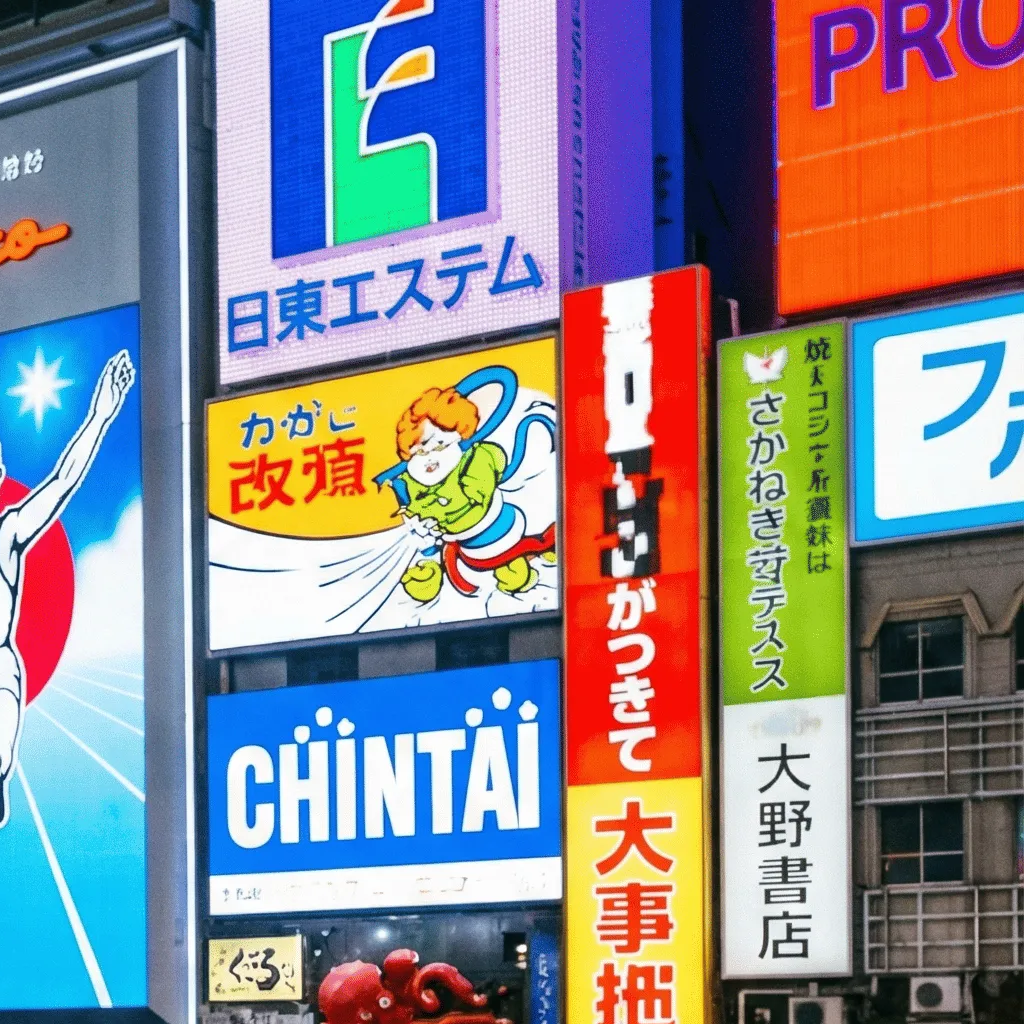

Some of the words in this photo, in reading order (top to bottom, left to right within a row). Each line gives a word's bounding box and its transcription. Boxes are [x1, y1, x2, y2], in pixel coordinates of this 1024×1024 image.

[227, 235, 544, 353] 日東エステム
[757, 743, 814, 960] 大野書店
